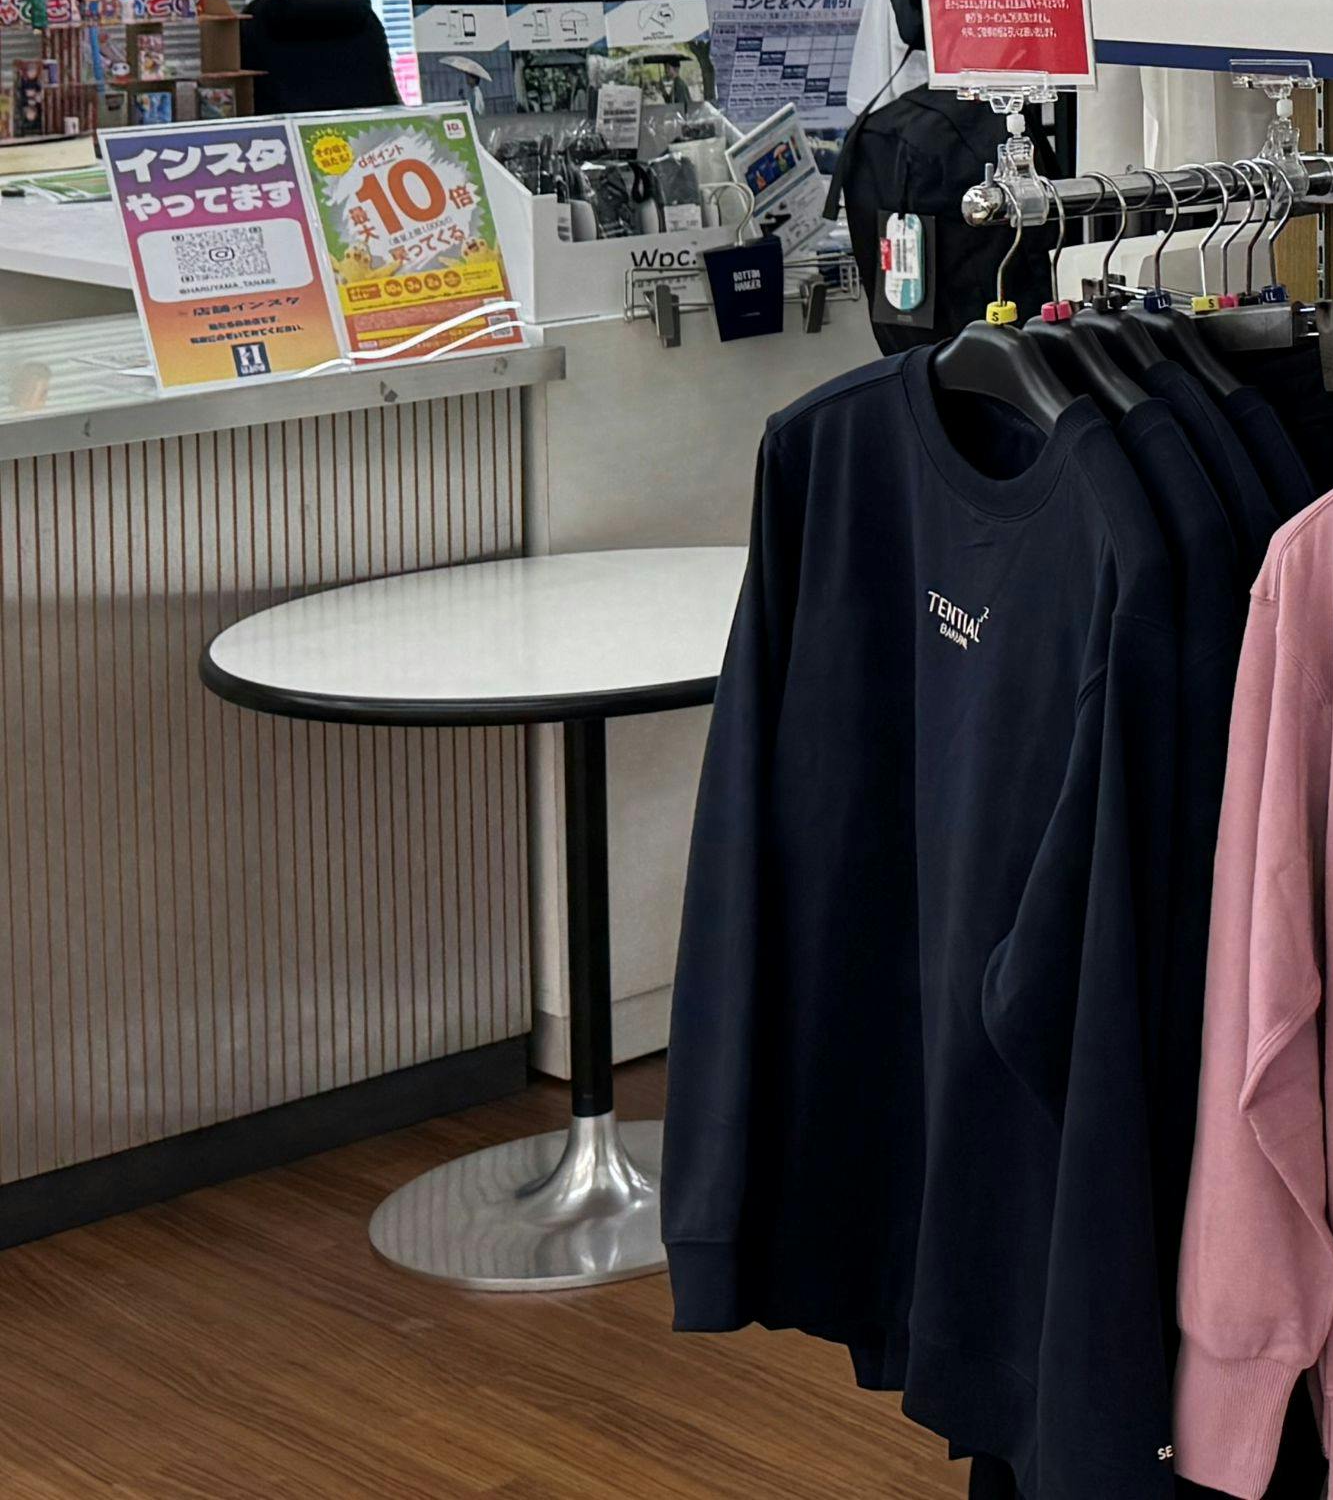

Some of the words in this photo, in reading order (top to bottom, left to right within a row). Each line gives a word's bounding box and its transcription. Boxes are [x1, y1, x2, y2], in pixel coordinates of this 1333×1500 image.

[115, 138, 287, 184] インスタ
[126, 180, 296, 223] やってます
[355, 158, 447, 236] 10
[449, 184, 474, 210] 倍
[630, 248, 698, 269] Wpc.
[927, 590, 981, 643] TENTIAL
